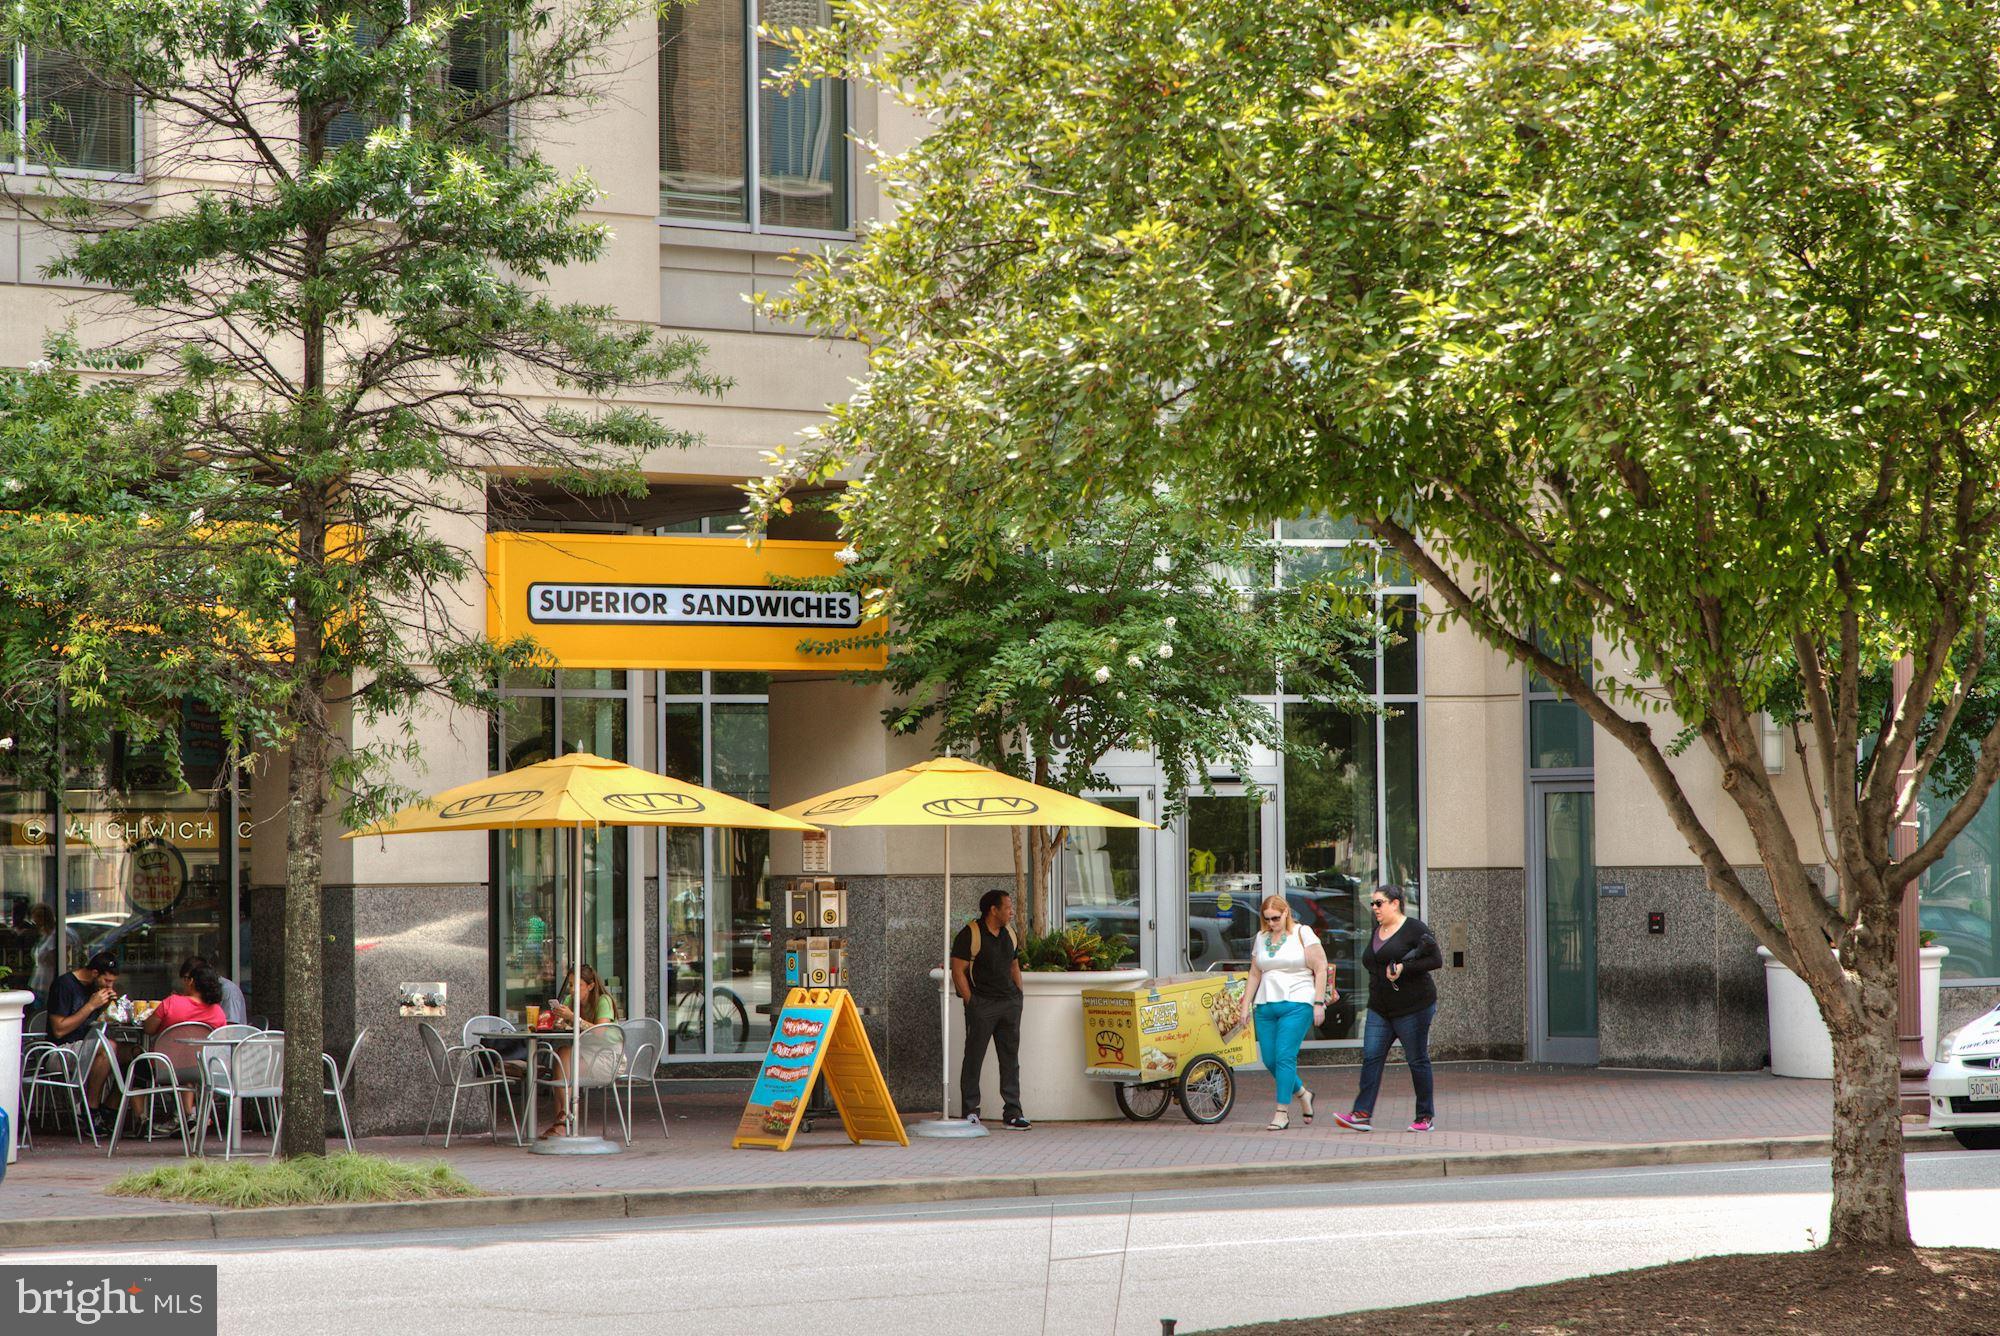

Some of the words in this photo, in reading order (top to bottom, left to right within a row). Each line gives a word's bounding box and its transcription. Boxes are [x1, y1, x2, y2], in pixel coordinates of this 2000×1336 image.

[540, 589, 667, 615] SUPERIOR
[681, 593, 851, 618] SANDWICHES
[147, 821, 213, 841] WICH
[133, 872, 177, 885] Order
[795, 912, 803, 922] 4
[826, 911, 834, 922] 5
[815, 971, 823, 981] 9
